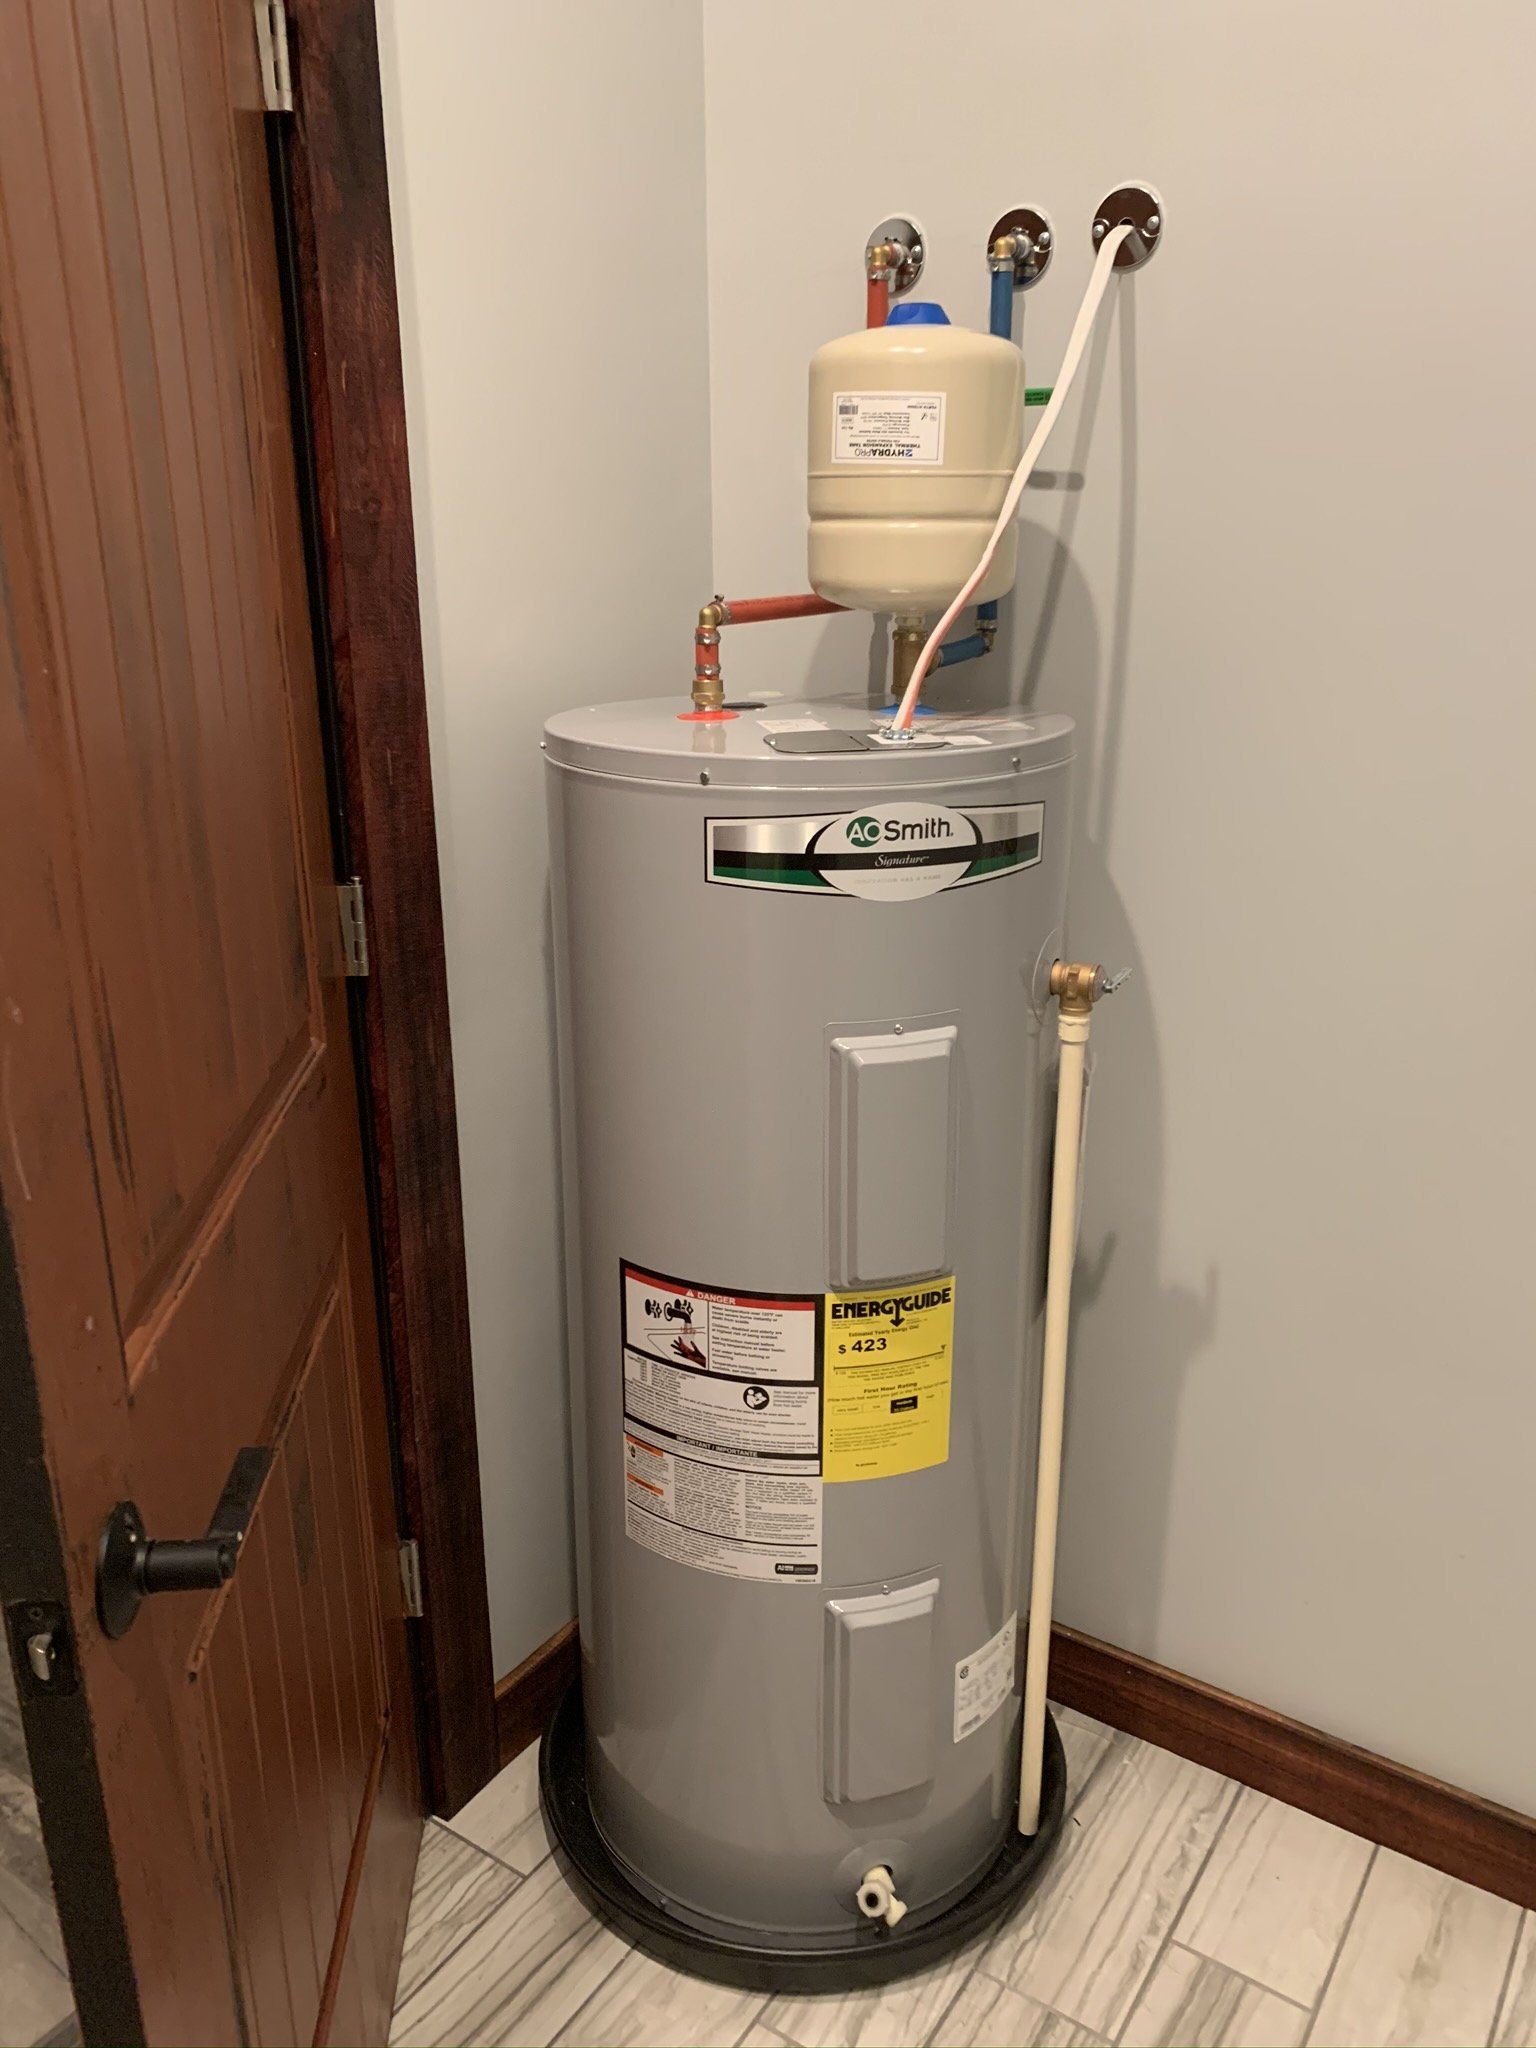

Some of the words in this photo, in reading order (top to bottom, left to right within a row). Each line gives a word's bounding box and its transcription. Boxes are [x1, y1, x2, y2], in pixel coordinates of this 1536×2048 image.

[697, 1292, 736, 1305] DANGER
[831, 1287, 951, 1320] ENERGYGUIDE
[839, 1344, 846, 1354] $
[852, 1338, 887, 1352] 423
[897, 1382, 918, 1390] Rating
[676, 1436, 710, 1450] IMPORTANT
[715, 1446, 757, 1457] IMPORTANTE
